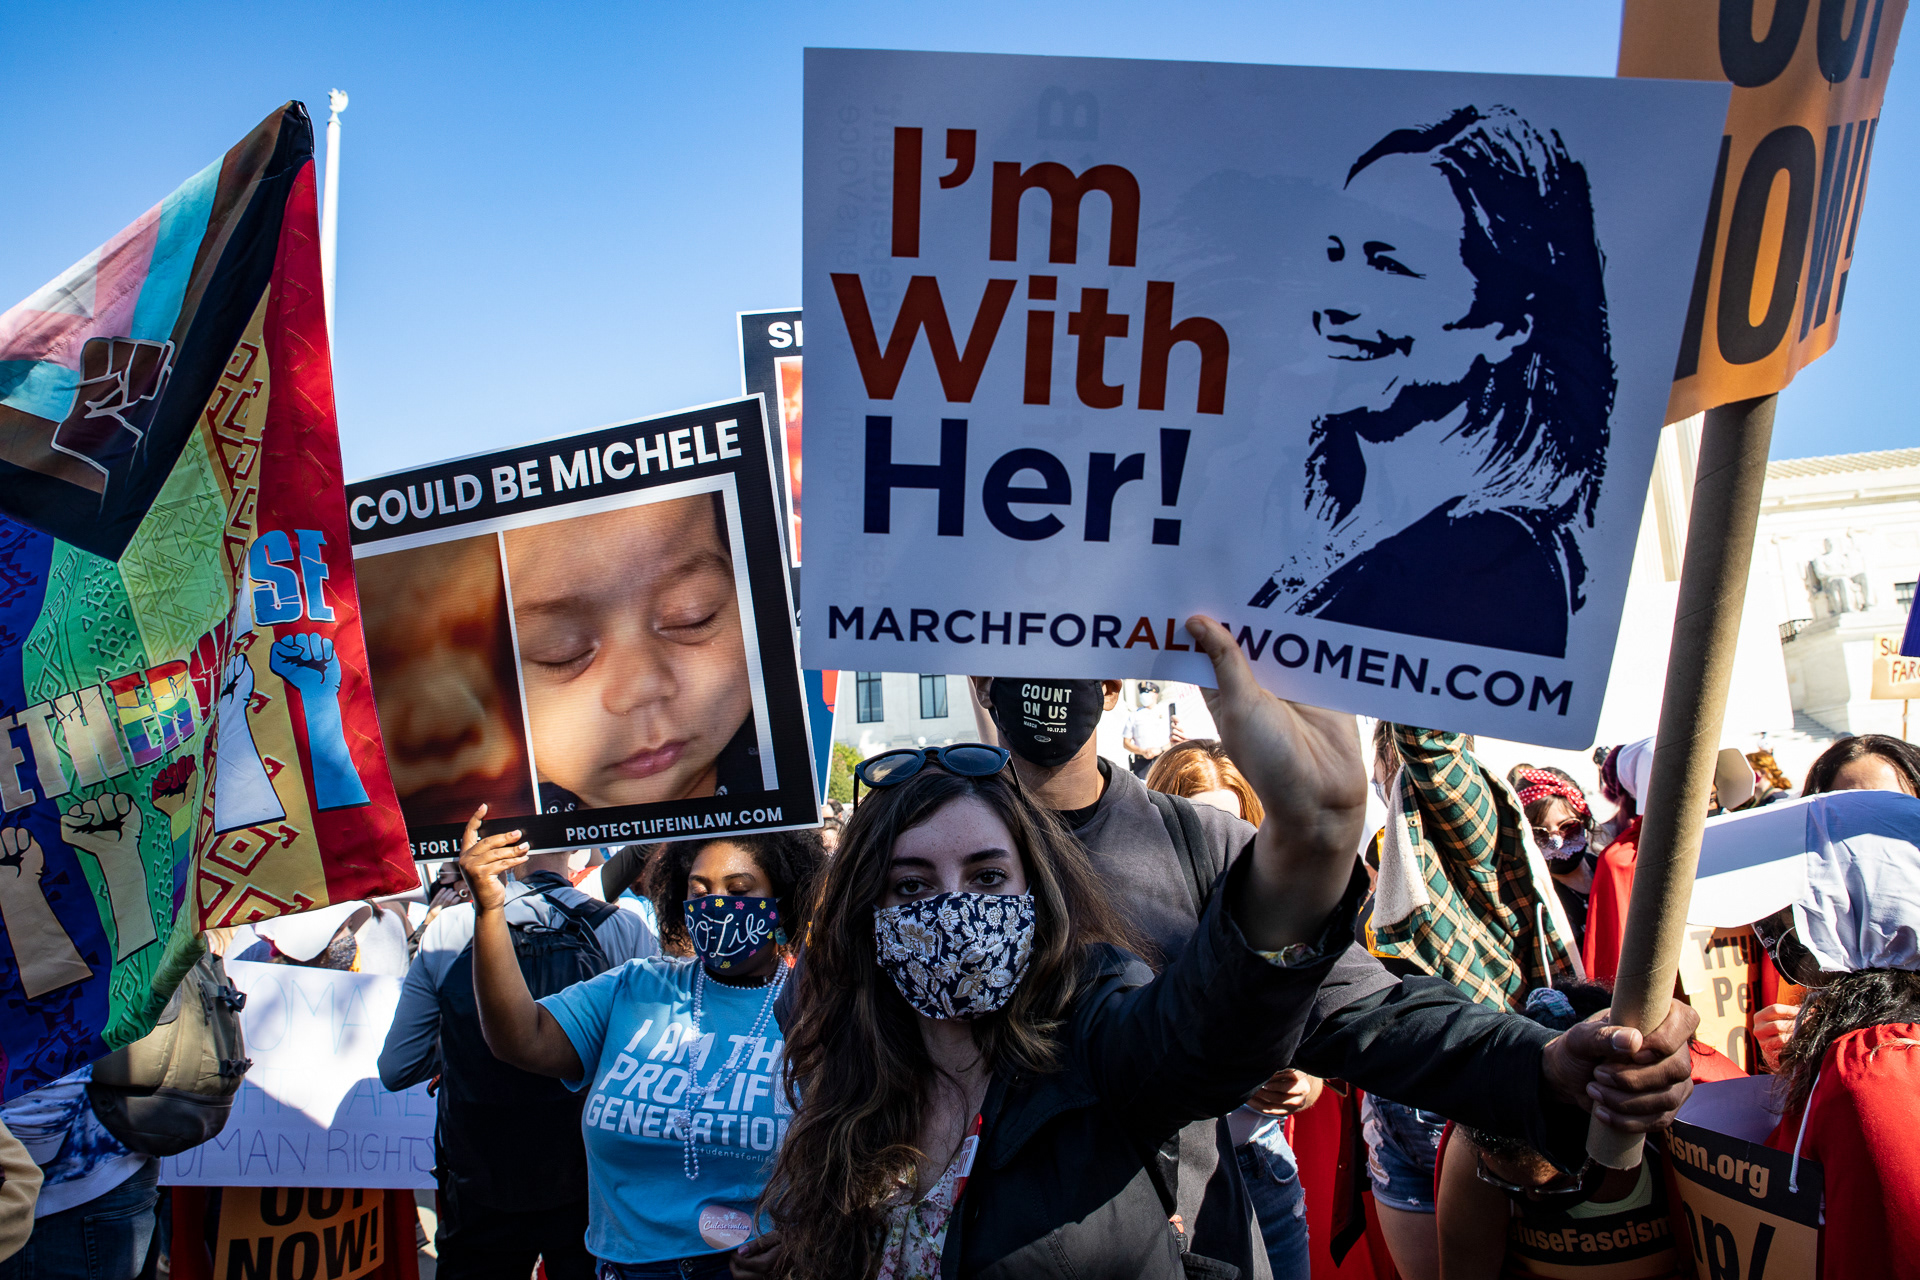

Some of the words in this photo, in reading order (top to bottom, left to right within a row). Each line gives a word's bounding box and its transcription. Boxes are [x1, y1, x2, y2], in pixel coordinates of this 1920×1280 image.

[891, 126, 1141, 267] I'm
[829, 273, 1230, 415] With
[350, 474, 483, 532] COULD
[491, 459, 543, 503] BE
[549, 418, 742, 493] MICHELE
[863, 414, 1192, 546] Her!
[828, 605, 1574, 716] MARCHFORALWOMEN.COM
[1021, 683, 1072, 703] COUNT
[1023, 701, 1041, 717] ON
[1048, 705, 1068, 720] US
[419, 840, 450, 856] FOR
[565, 807, 783, 842] PROTECTLIFEINLAW.COM
[624, 1019, 653, 1054] I
[647, 1022, 716, 1071] AM
[726, 1034, 788, 1074] TH
[160, 1126, 311, 1180] UMAN
[226, 1206, 379, 1280] NOW!
